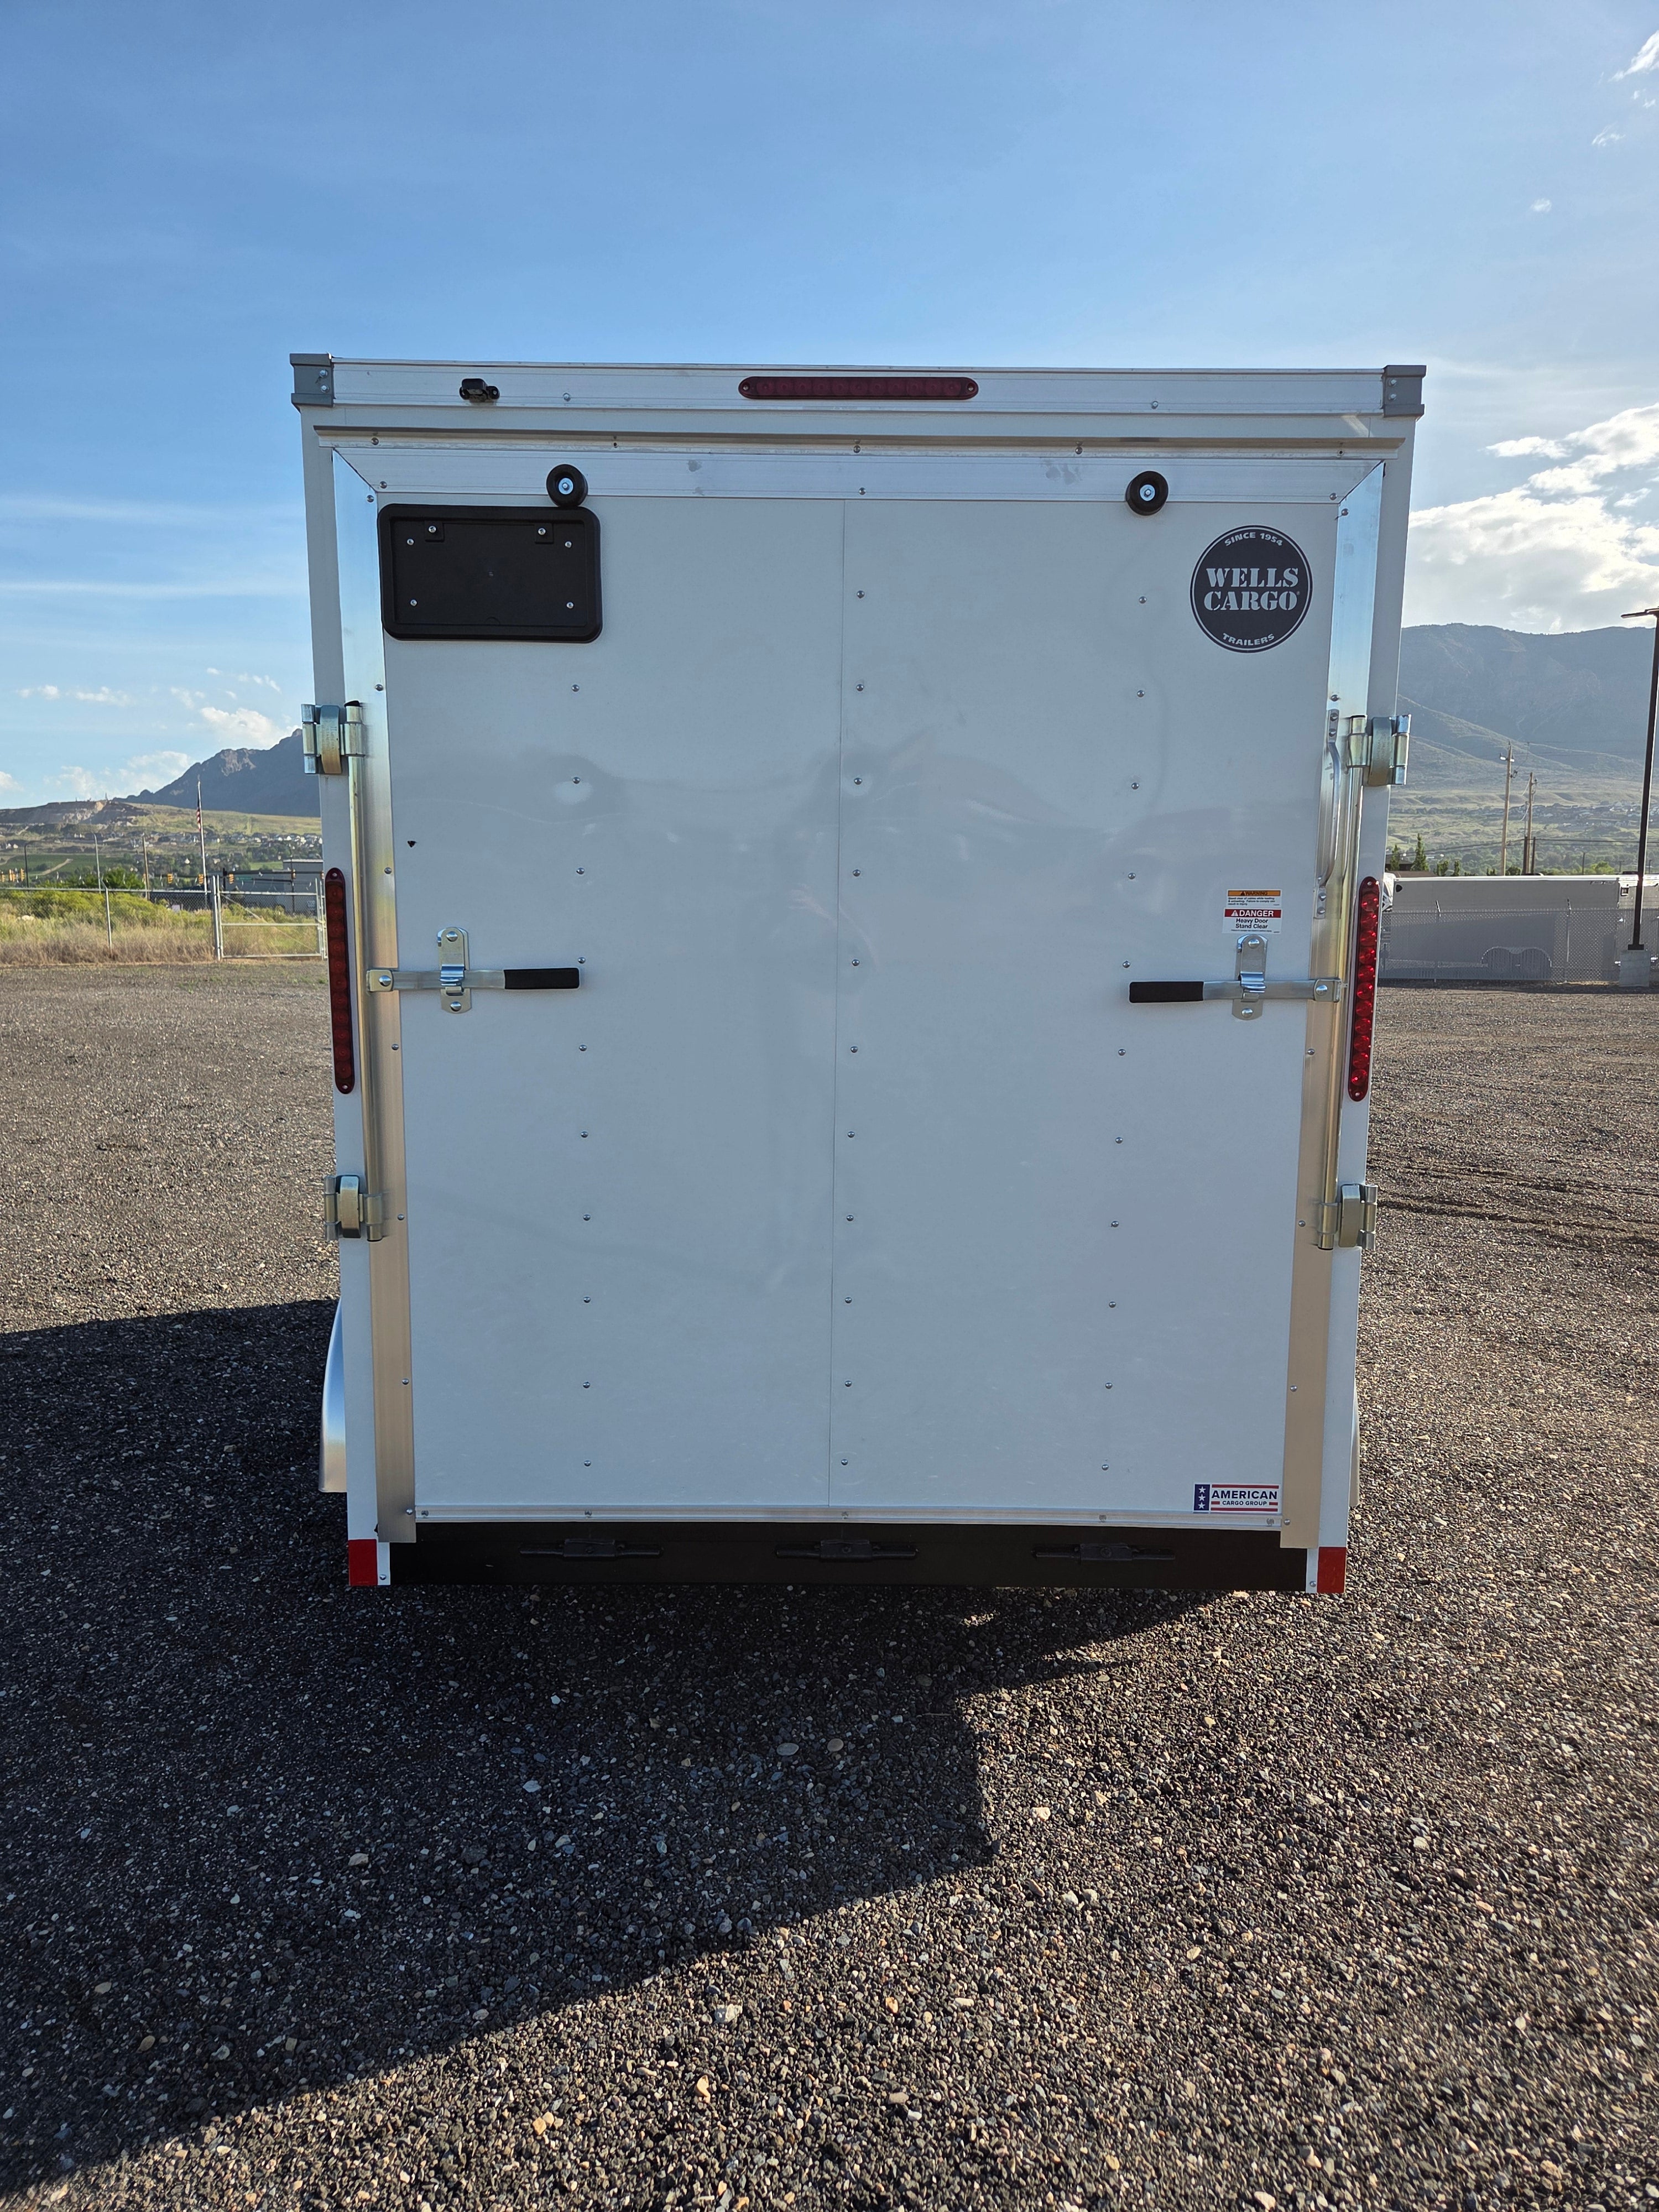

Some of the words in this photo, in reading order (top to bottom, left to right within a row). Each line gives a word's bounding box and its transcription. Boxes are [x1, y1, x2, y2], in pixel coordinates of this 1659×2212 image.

[1224, 532, 1256, 546] SINCE
[1260, 533, 1284, 546] 1954
[1206, 568, 1298, 587] WELLS
[1203, 591, 1297, 611] CARGO
[1223, 633, 1275, 646] TRAILERS
[1211, 1490, 1277, 1499] AMERICAN
